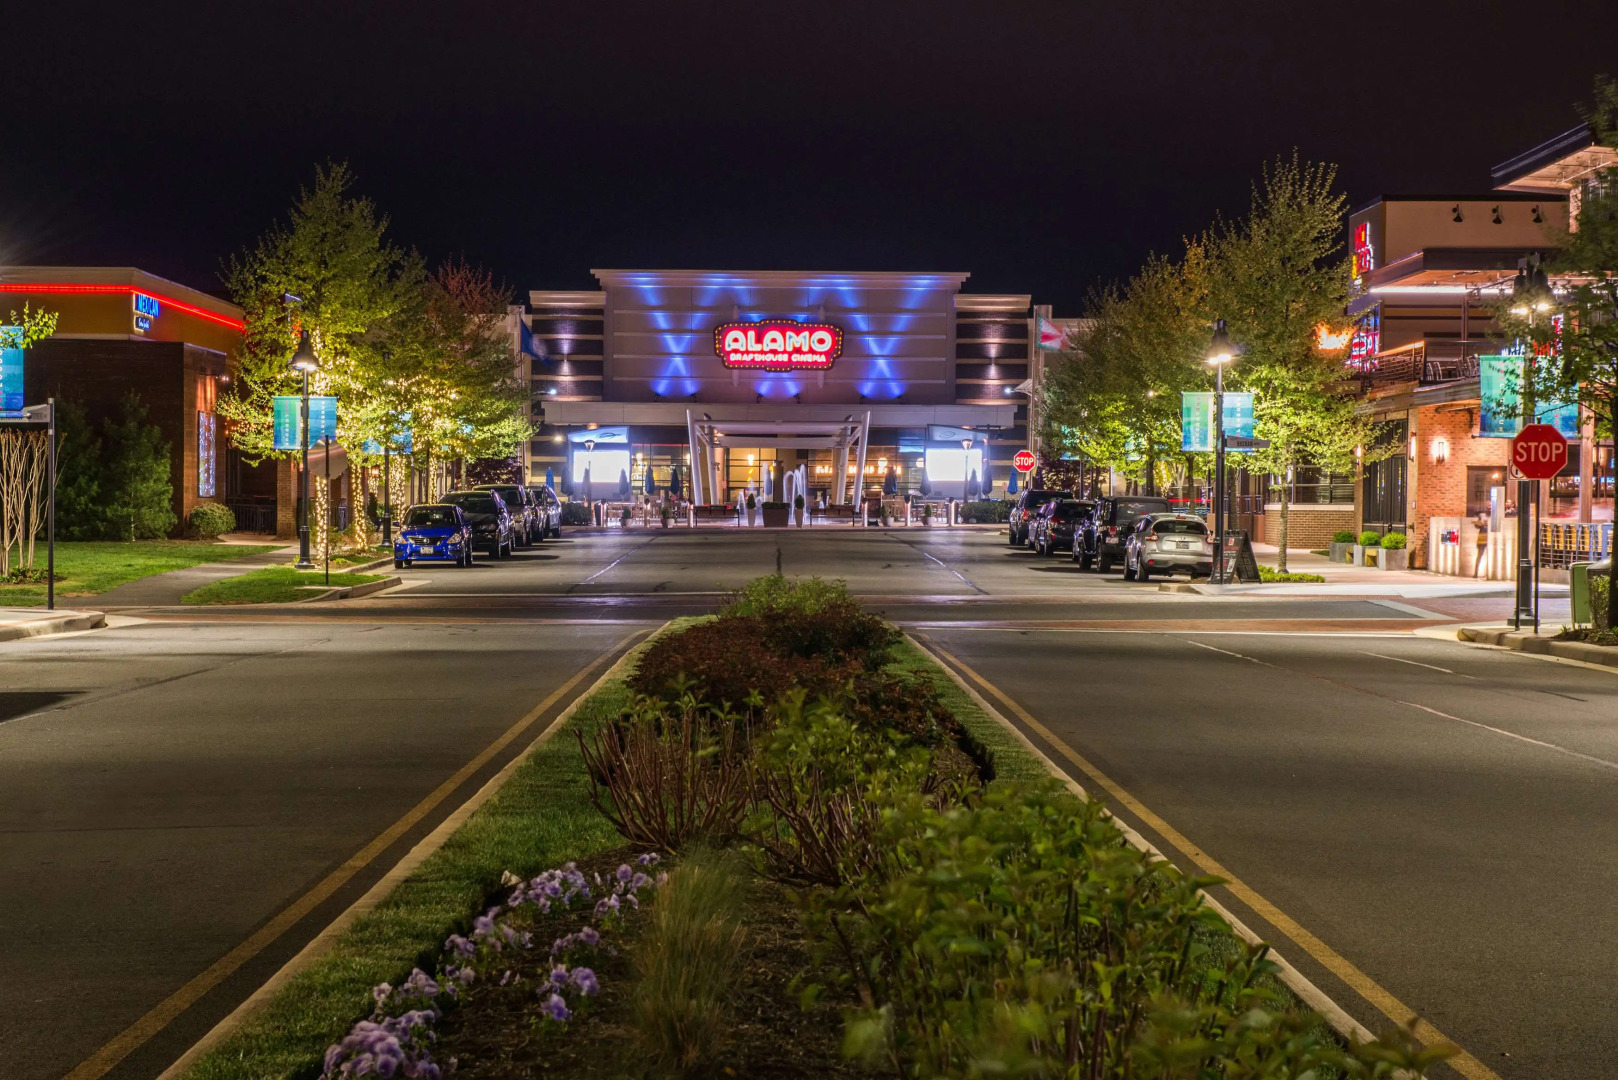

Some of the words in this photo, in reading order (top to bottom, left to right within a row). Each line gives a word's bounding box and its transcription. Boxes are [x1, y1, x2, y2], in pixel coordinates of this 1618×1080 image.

[725, 330, 832, 352] ALAMO
[729, 353, 788, 362] DRAFTHOUSE
[791, 353, 826, 362] CINEMA
[1516, 442, 1564, 462] STOP
[1015, 457, 1034, 466] STOP
